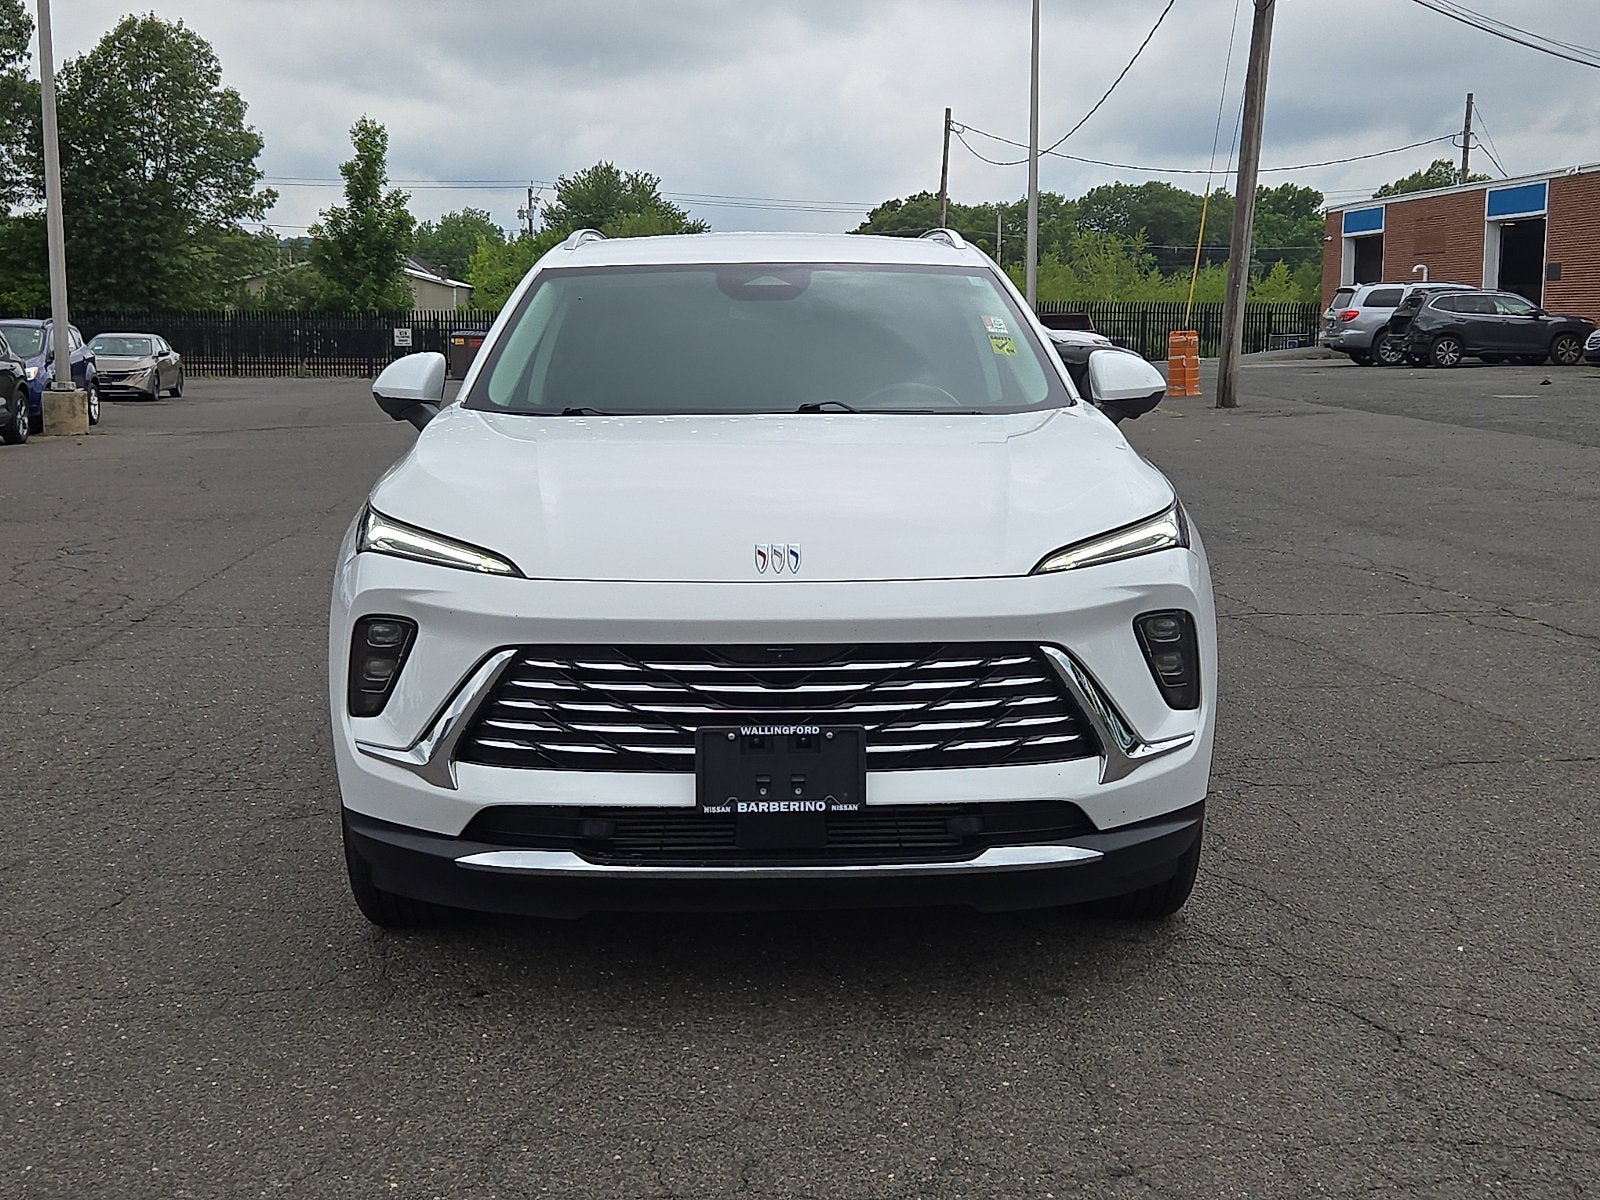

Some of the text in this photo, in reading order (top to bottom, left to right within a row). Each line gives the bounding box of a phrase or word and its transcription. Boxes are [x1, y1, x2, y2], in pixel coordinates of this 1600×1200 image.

[740, 726, 820, 735] WALLINGFORD
[737, 801, 826, 813] BARBERINO
[831, 804, 859, 812] NISSAN
